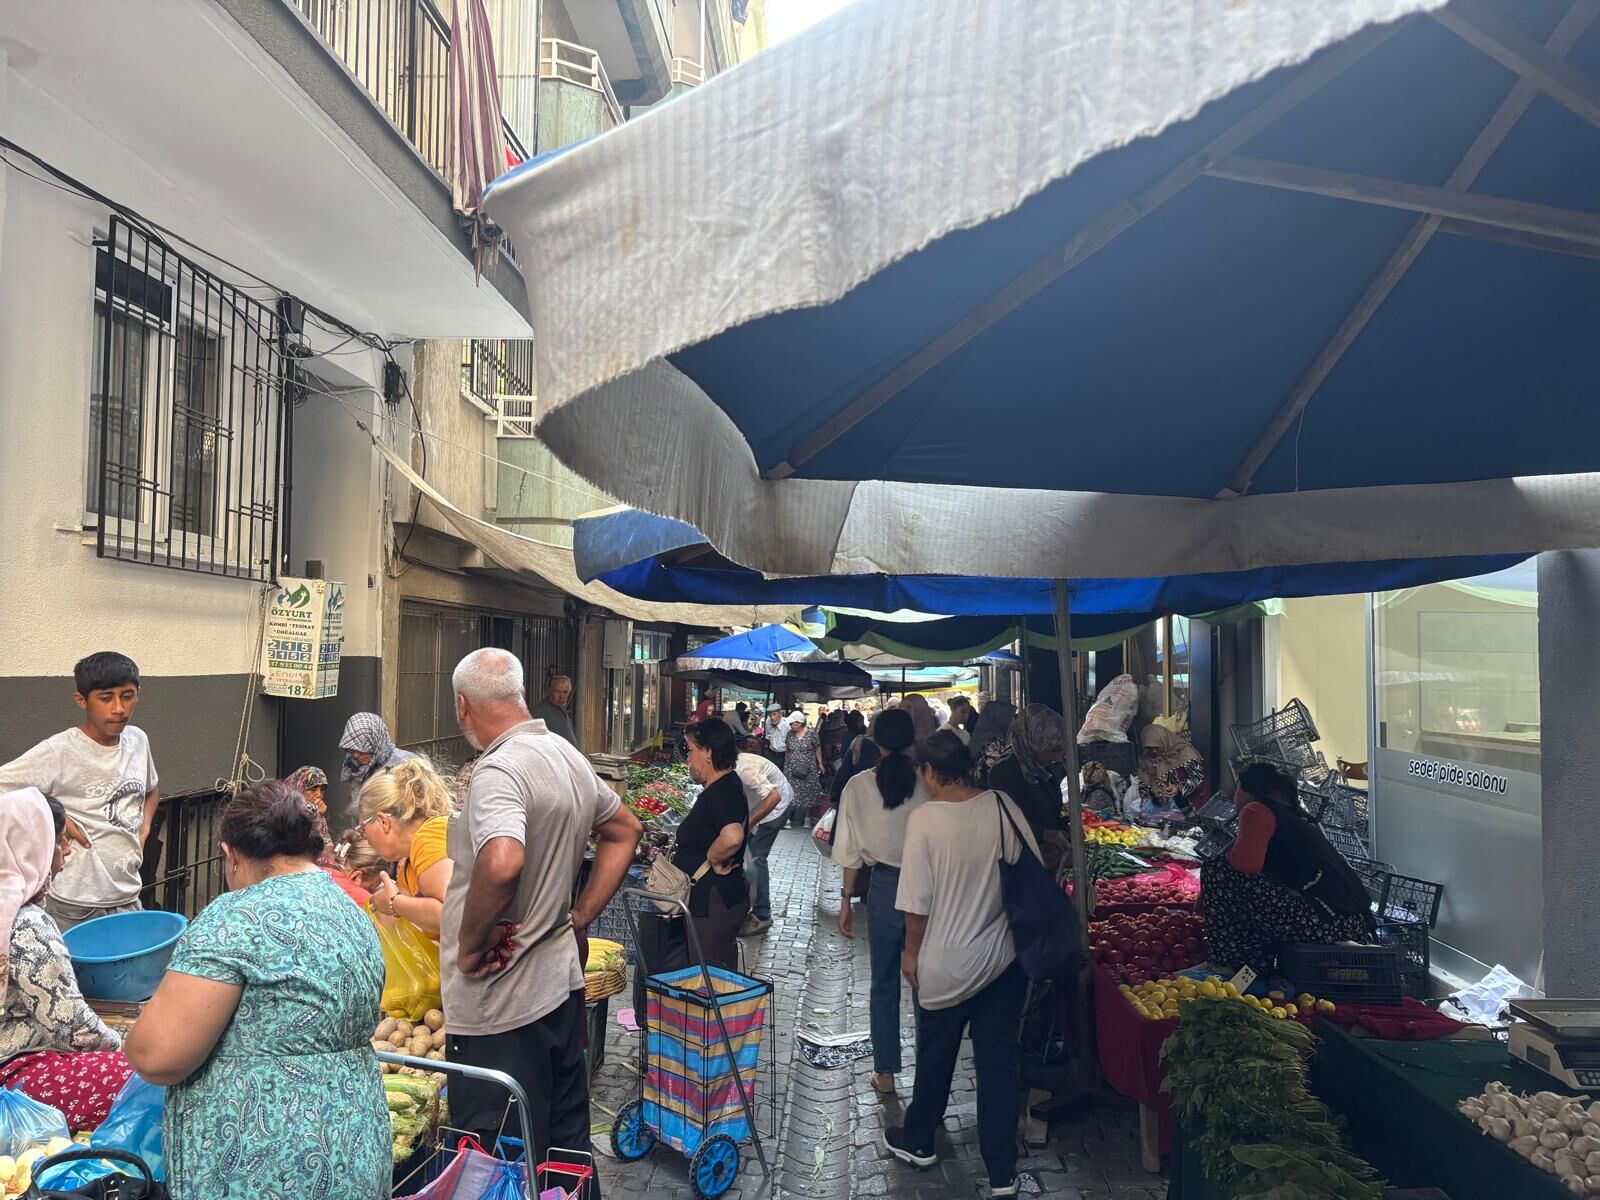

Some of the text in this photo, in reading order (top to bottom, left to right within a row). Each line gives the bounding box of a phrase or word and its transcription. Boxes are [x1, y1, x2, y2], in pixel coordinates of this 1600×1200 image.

[271, 607, 312, 618] ÖZYURT
[288, 685, 309, 696] 187
[1408, 759, 1507, 793] sedef pide salonu
